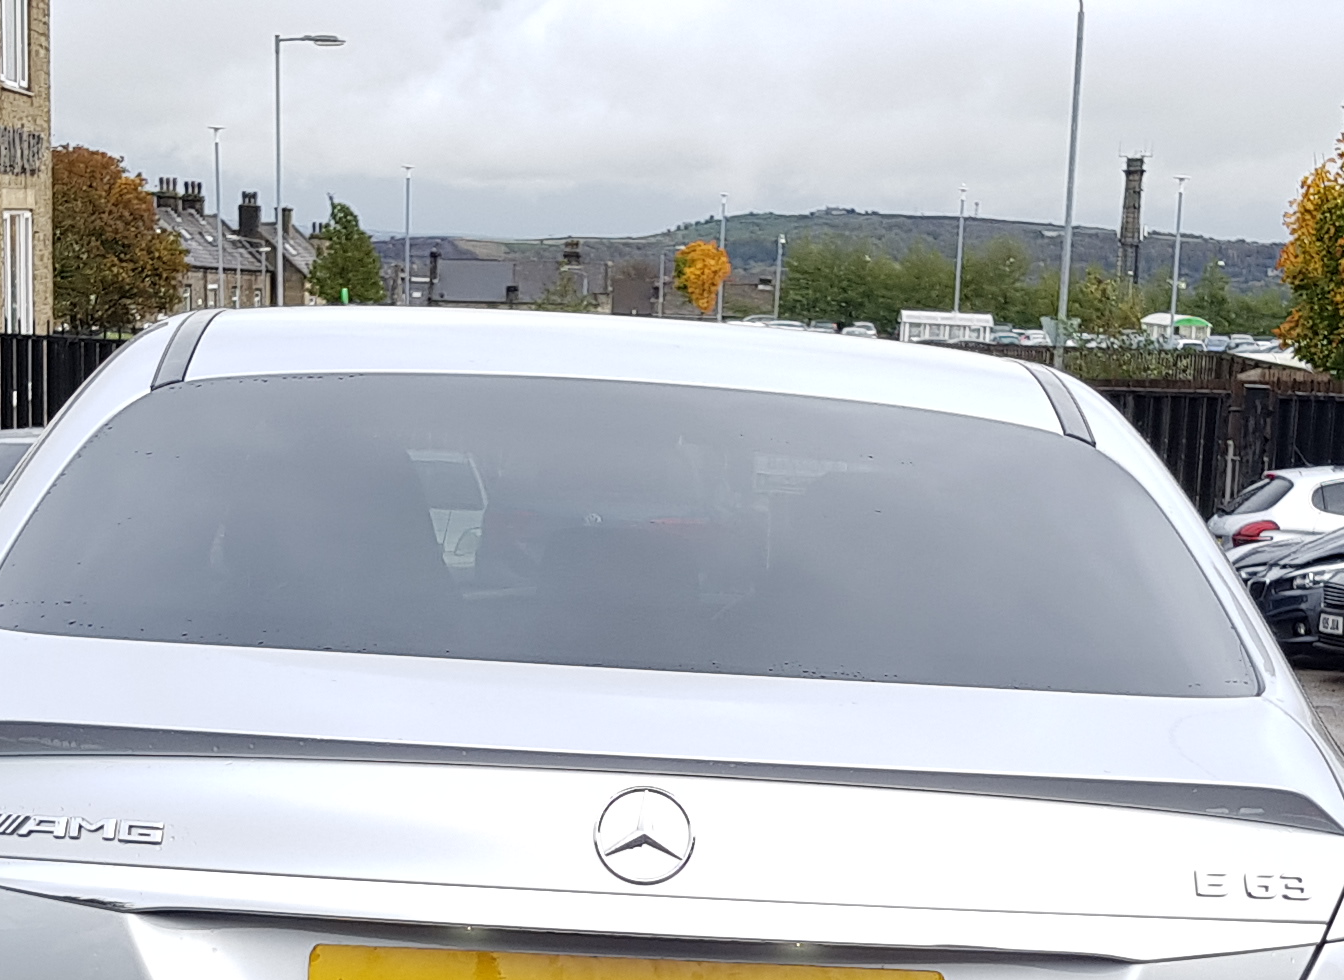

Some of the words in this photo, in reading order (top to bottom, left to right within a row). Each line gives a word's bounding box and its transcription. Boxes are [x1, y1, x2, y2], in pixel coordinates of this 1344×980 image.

[16, 814, 165, 846] AMG
[1193, 869, 1228, 899] E
[1243, 872, 1312, 902] 63
